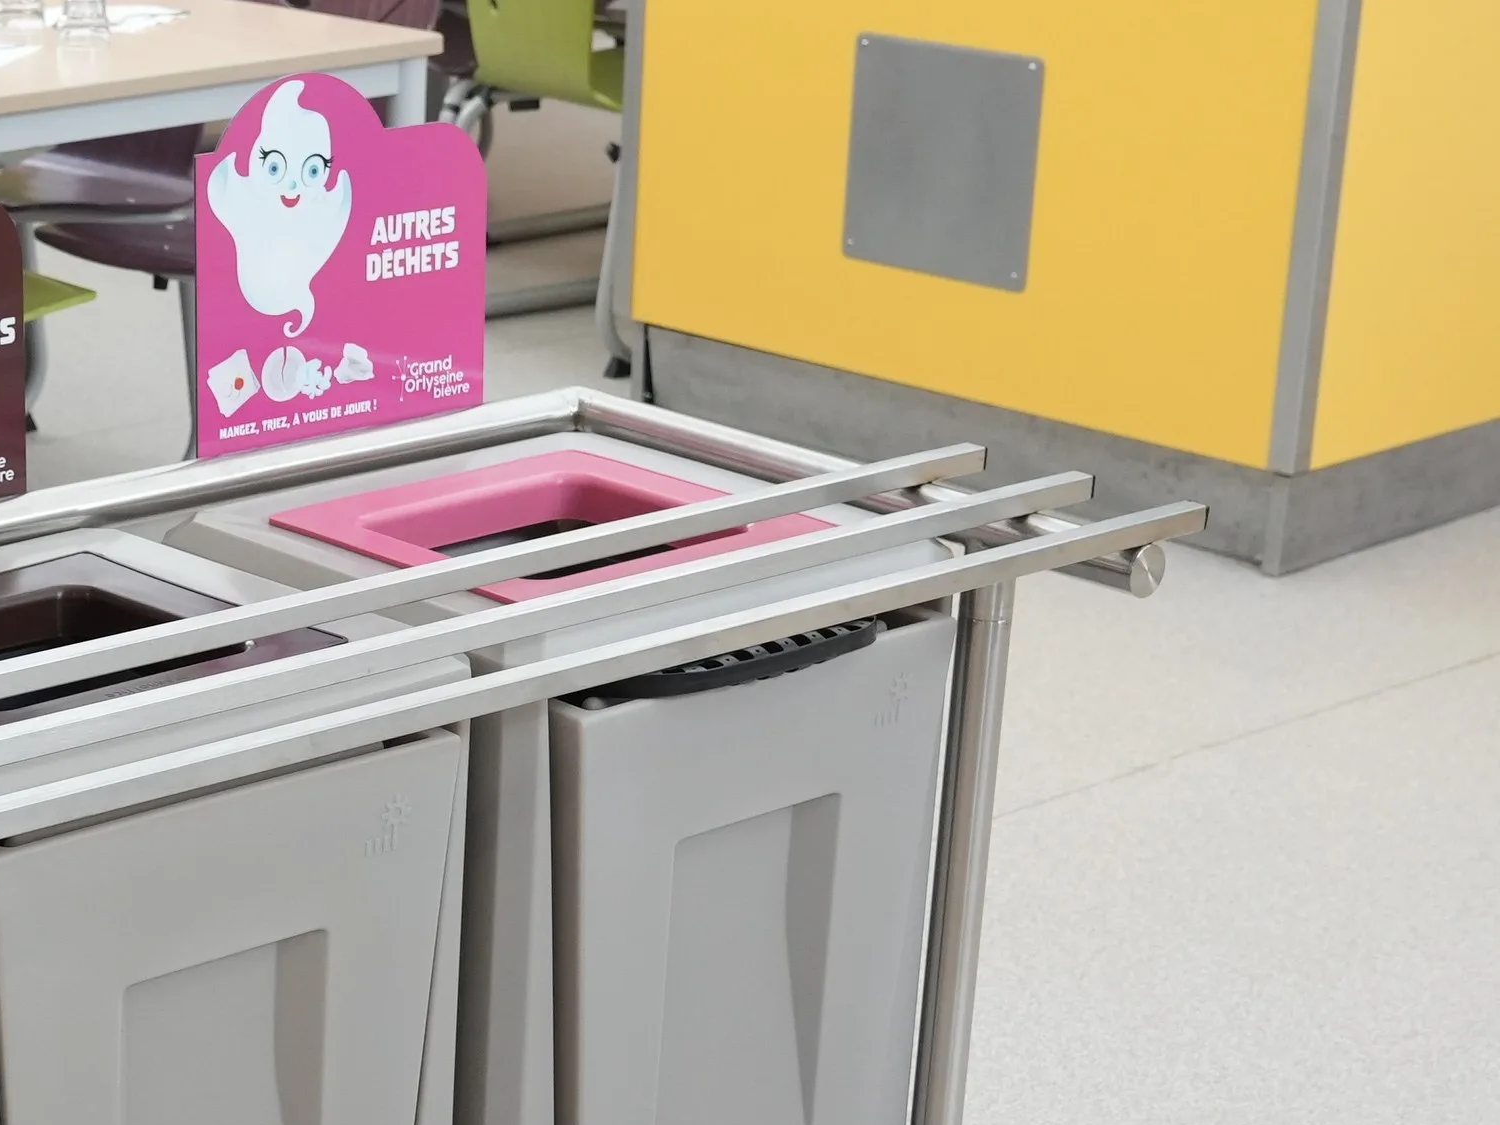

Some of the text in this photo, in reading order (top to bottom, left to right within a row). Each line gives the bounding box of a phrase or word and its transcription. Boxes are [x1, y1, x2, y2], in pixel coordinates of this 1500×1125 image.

[370, 205, 456, 246] AUTRES
[365, 240, 460, 282] DÉCHETS
[409, 354, 452, 376] Grand
[219, 422, 260, 440] MANGEZ,
[261, 416, 290, 432] TRIEZ,
[302, 409, 328, 424] VOUS
[330, 406, 342, 418] DE
[343, 400, 371, 416] JOUER
